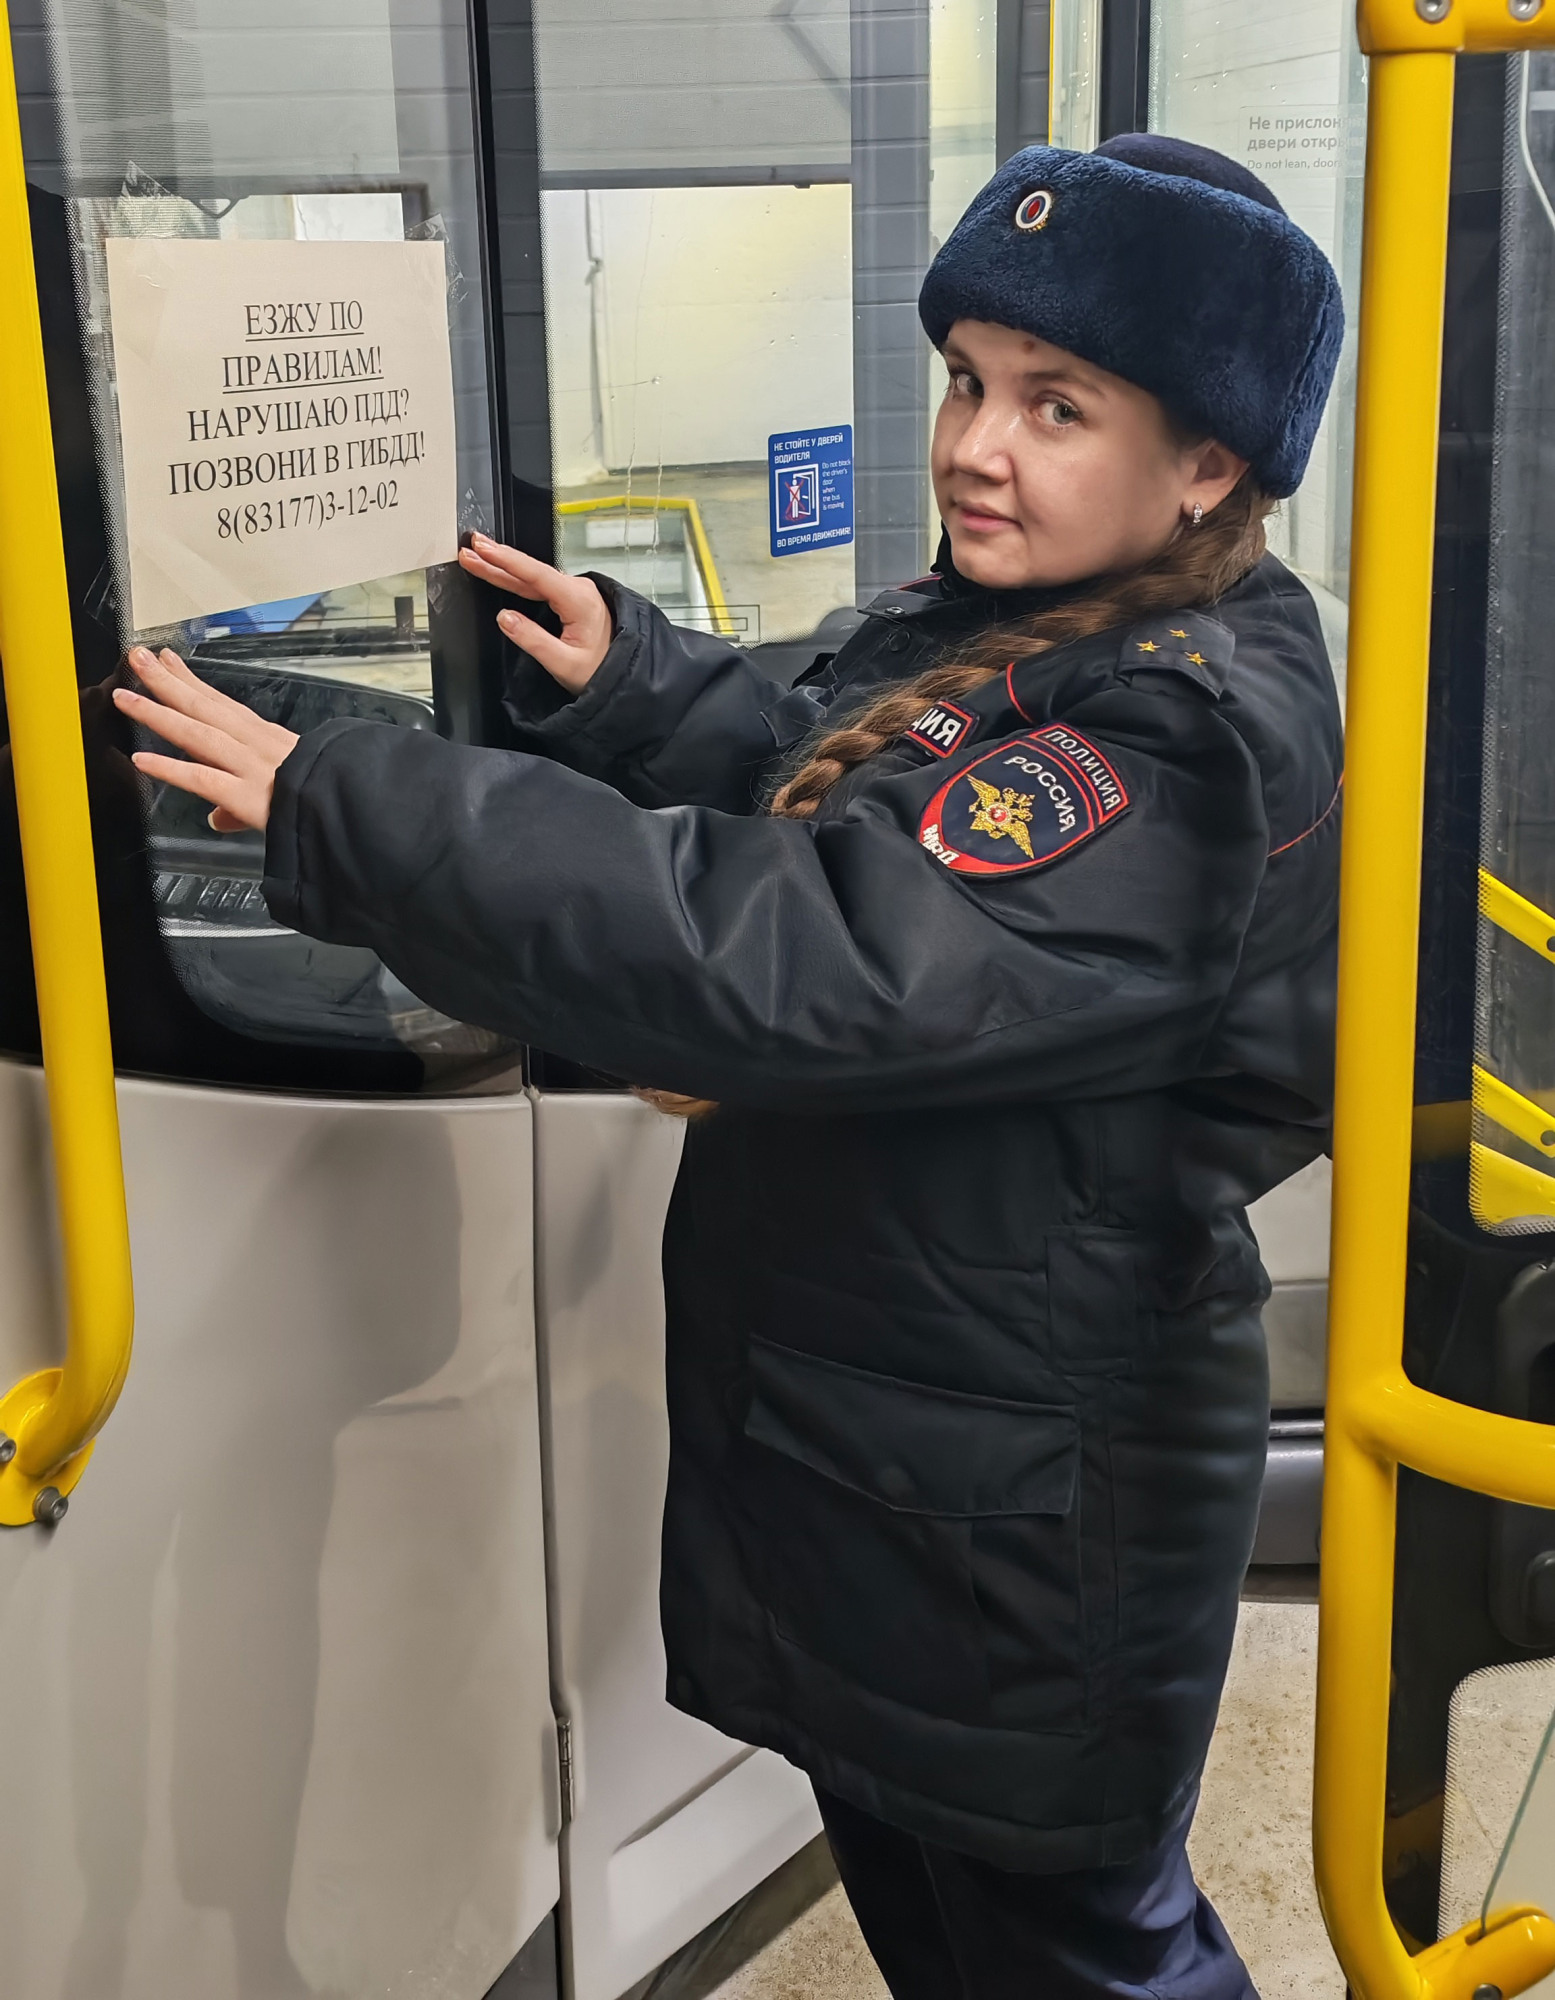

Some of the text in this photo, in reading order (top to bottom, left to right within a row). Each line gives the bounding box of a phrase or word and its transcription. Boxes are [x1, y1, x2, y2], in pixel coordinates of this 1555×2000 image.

[1249, 116, 1350, 132] Не прислон
[1247, 138, 1297, 151] двери
[1247, 160, 1263, 169] Do
[1264, 160, 1282, 169] not
[1284, 159, 1311, 169] lean,
[244, 300, 364, 336] ЕЗЖУ ПО
[222, 345, 383, 388] ПРАВИЛАМ!
[187, 388, 410, 442] НАРУШАЮ ПДД?
[773, 433, 844, 452] НЕ СТОЙТЕ У ДВЕРЕЙ
[774, 451, 811, 464] ВОДИТЕЛЯ
[167, 430, 427, 496] ПОЗВОНИ В ГИБДД!
[216, 479, 400, 544] 8(83177)3-12-02
[776, 539, 787, 548] ВО
[787, 533, 812, 546] ВРЕМЯ
[1044, 730, 1122, 812] ПОЛИЦИЯ
[1002, 755, 1076, 833] РОССИЯ
